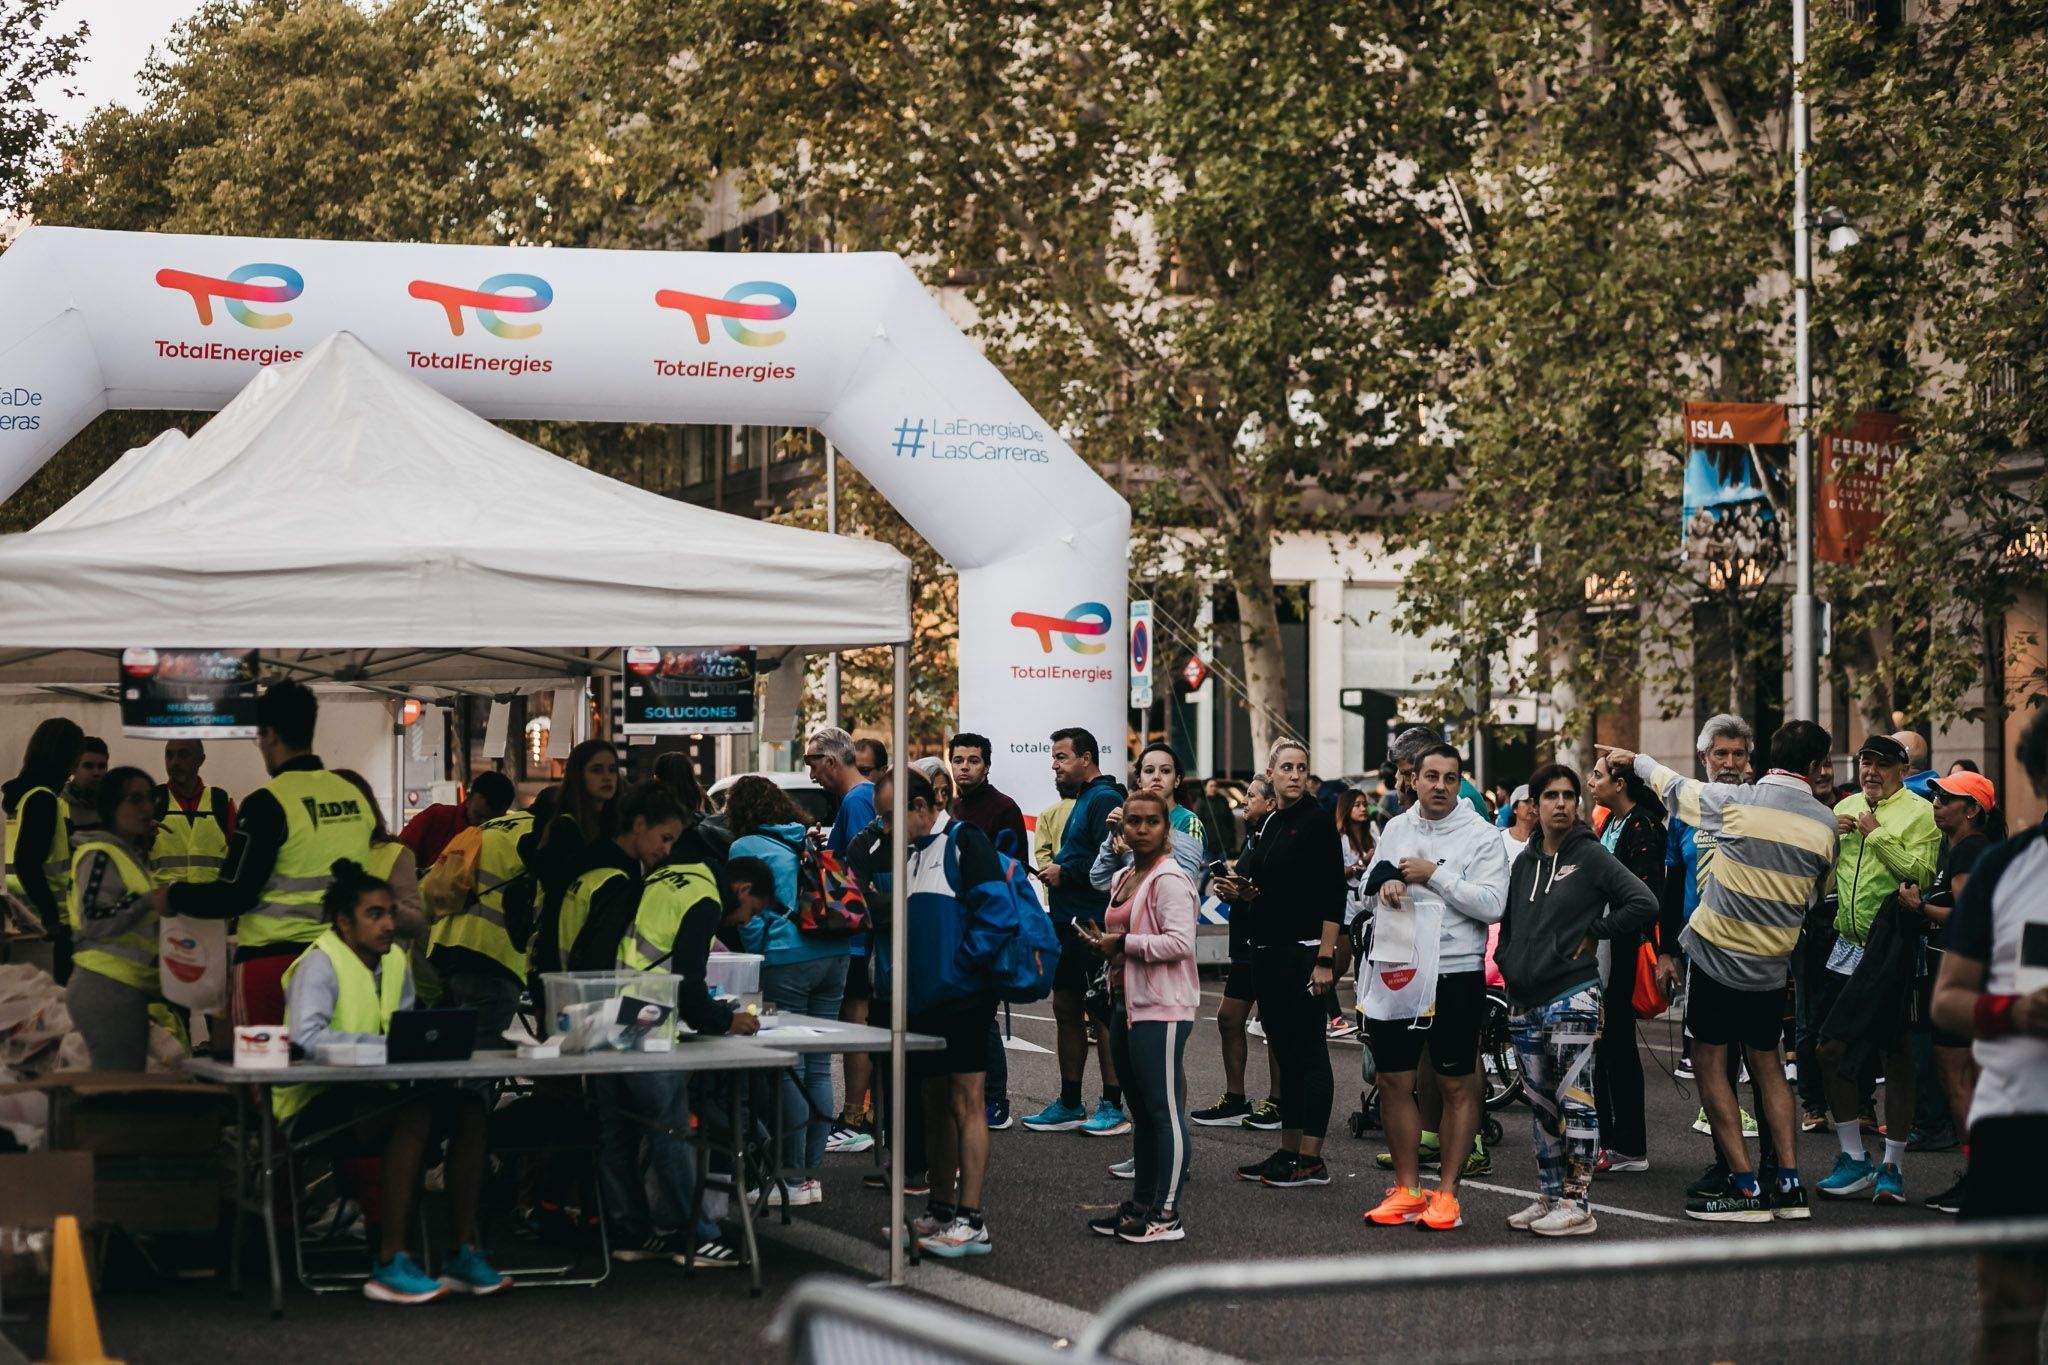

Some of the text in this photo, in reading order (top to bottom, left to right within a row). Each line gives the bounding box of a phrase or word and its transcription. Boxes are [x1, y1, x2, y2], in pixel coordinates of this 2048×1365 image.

[154, 340, 304, 366] TotalEnergies
[407, 351, 552, 375] TotalEnergies
[653, 360, 796, 383] TotalEnergies
[1690, 420, 1735, 440] ISLA
[931, 440, 1050, 464] LasCarreras
[1009, 666, 1113, 683] TotalEnergies
[644, 706, 738, 719] SOLUCIONES
[317, 800, 361, 818] ADM
